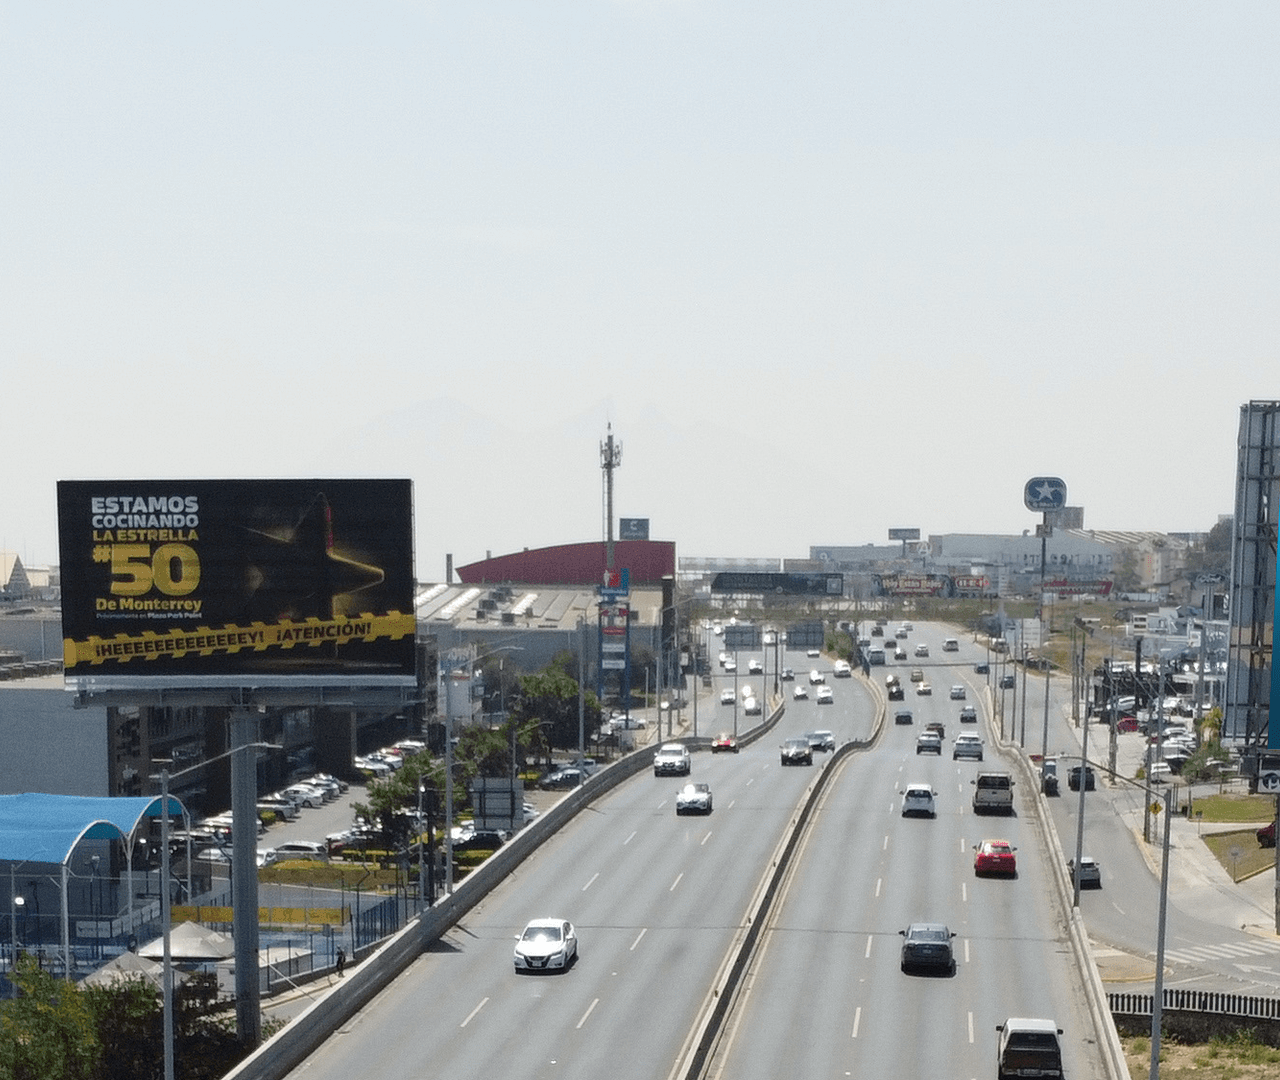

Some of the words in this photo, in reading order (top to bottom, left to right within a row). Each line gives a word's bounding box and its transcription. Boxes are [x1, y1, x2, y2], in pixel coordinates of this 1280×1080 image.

[91, 495, 199, 514] ESTAMOS
[91, 513, 199, 528] COCINANDO
[92, 529, 115, 542] LA
[117, 529, 199, 542] ESTRELLA
[92, 543, 201, 596] #50
[96, 598, 117, 611] De
[119, 597, 202, 614] Monterrey
